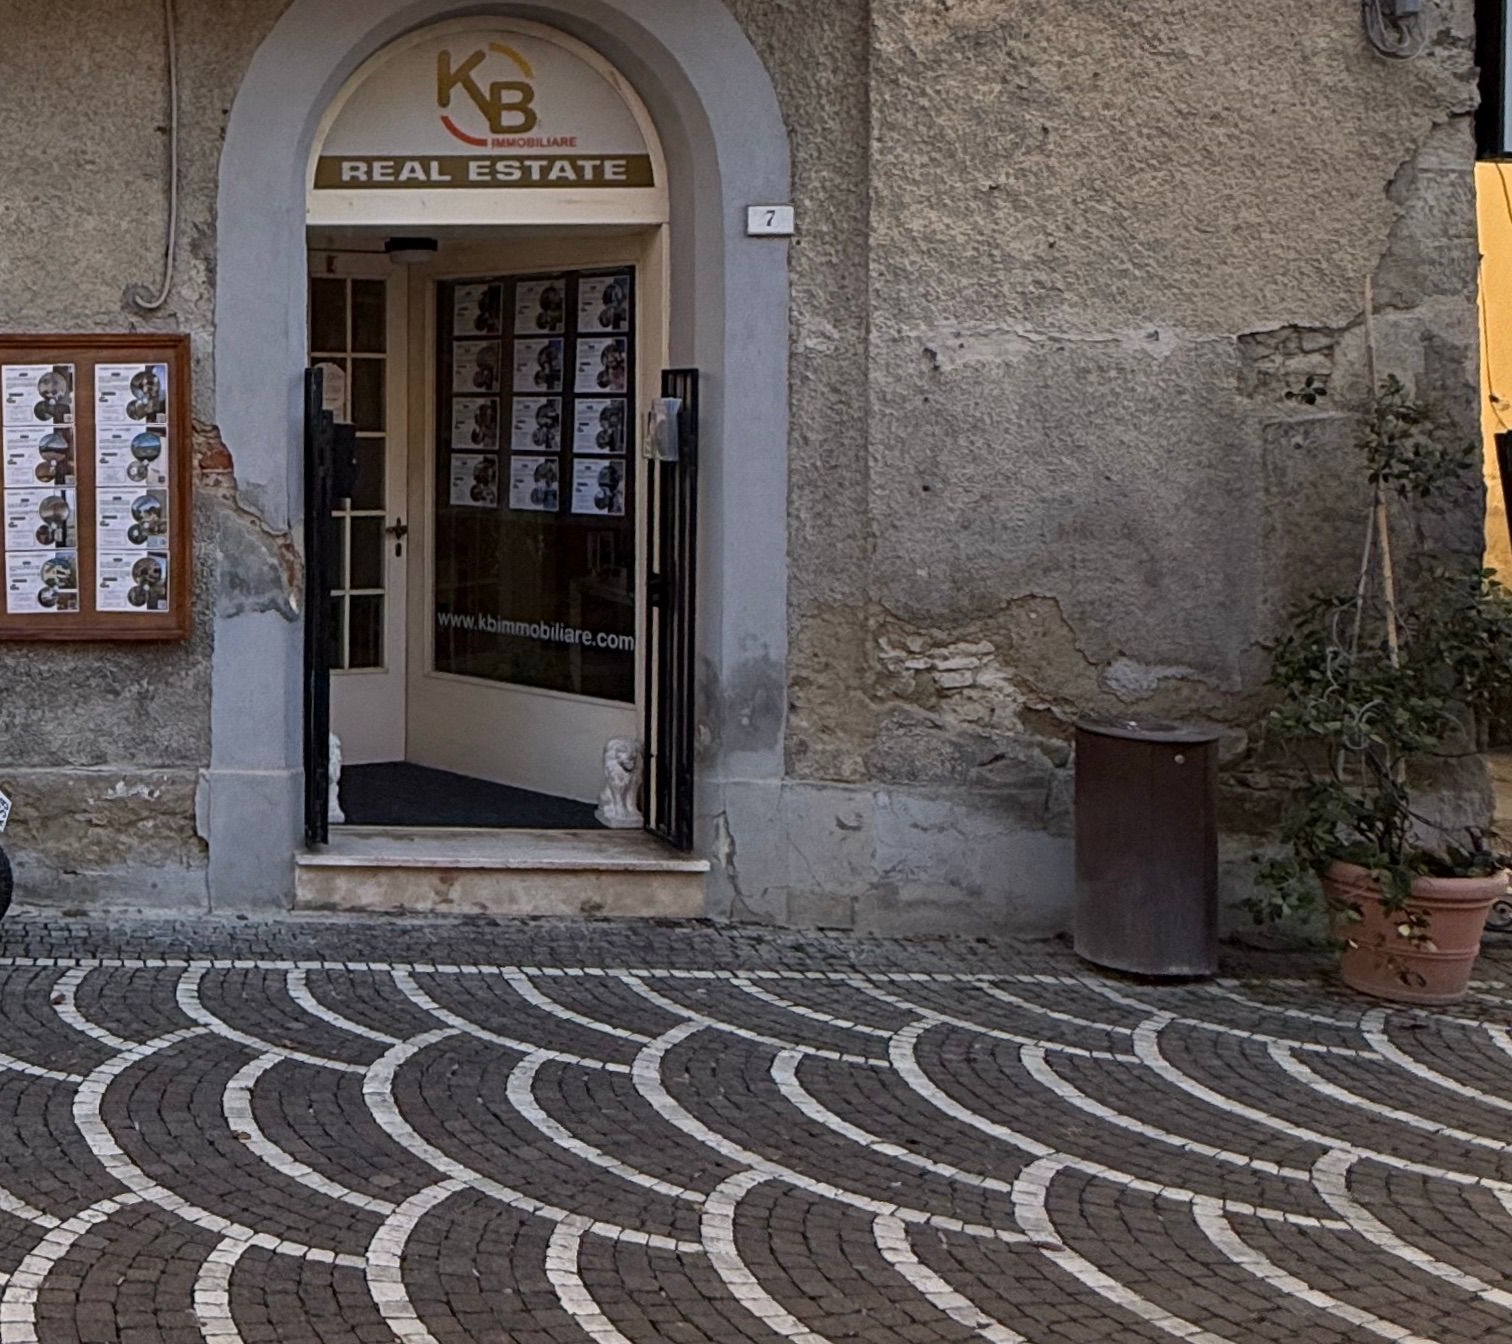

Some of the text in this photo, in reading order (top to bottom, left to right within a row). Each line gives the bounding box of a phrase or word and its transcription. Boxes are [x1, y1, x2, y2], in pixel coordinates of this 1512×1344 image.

[437, 49, 537, 134] KB
[491, 136, 577, 148] IMMOBILIARE
[341, 160, 627, 181] REAL ESTATE
[764, 210, 775, 226] 7
[438, 611, 634, 650] www.kbimmobiliare.com
